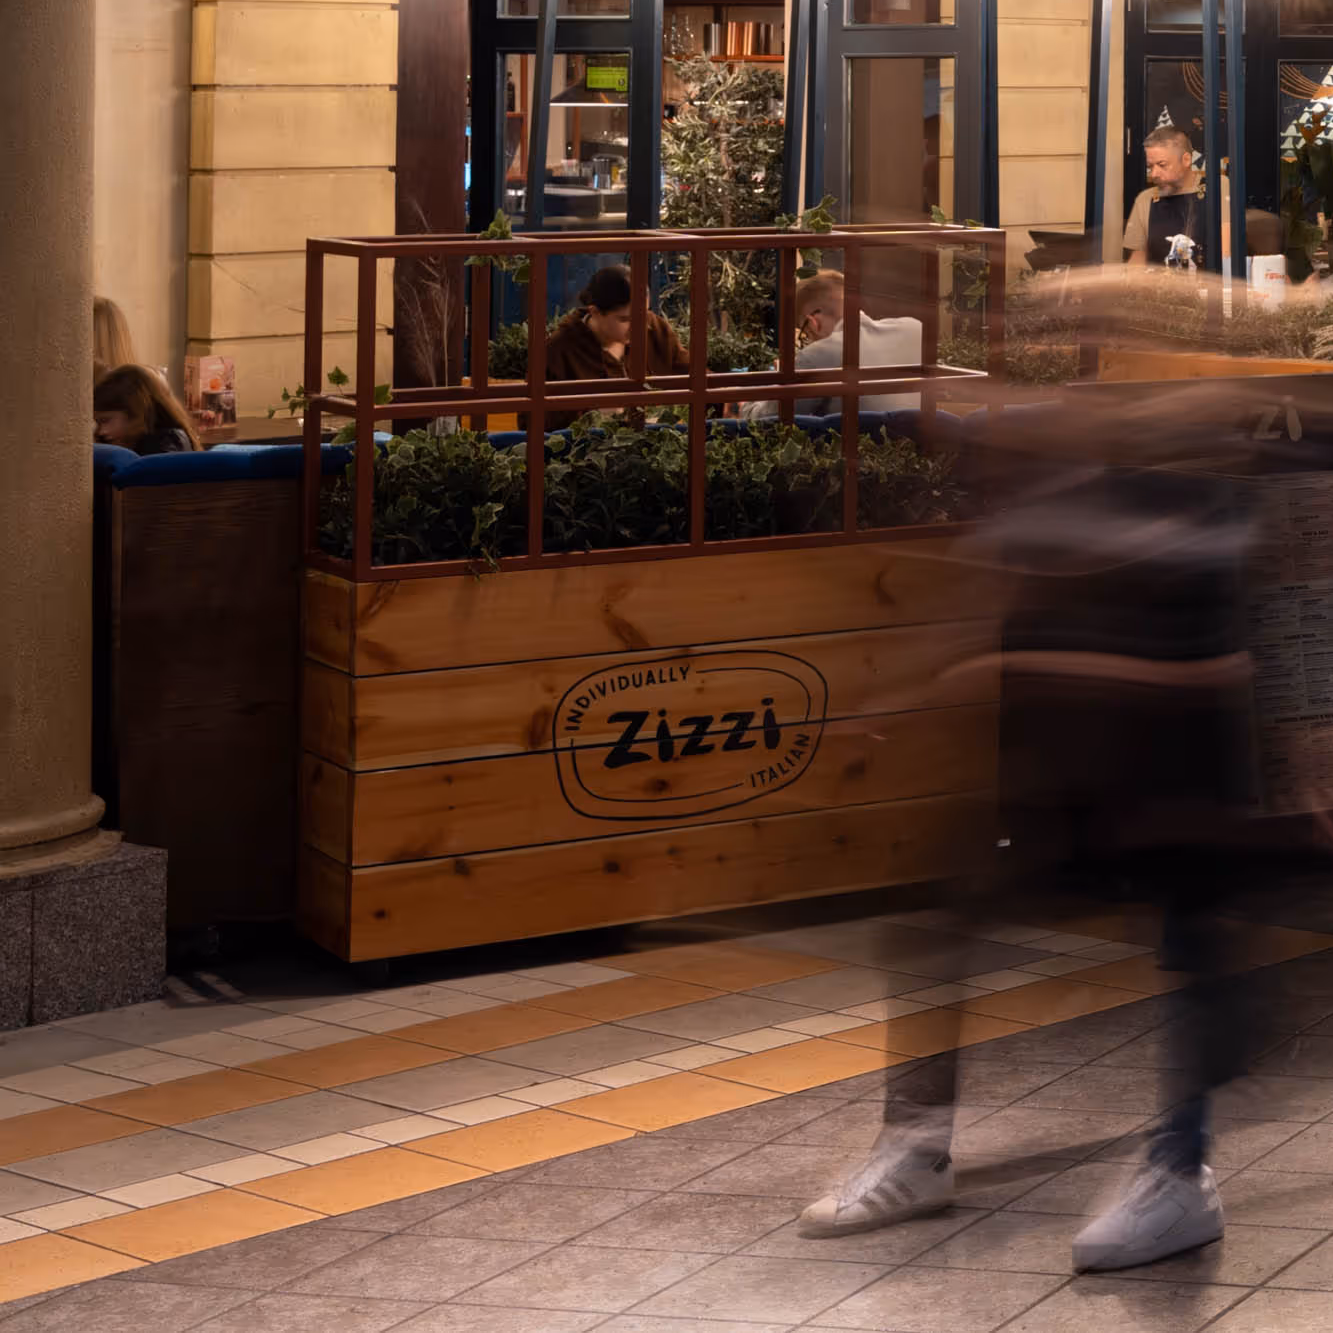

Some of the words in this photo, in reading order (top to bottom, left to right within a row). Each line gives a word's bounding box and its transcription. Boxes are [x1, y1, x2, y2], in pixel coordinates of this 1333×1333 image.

[564, 665, 691, 731] INDIVIDUALLY
[603, 697, 781, 769] Zizzi
[751, 732, 811, 788] ITALIAN
